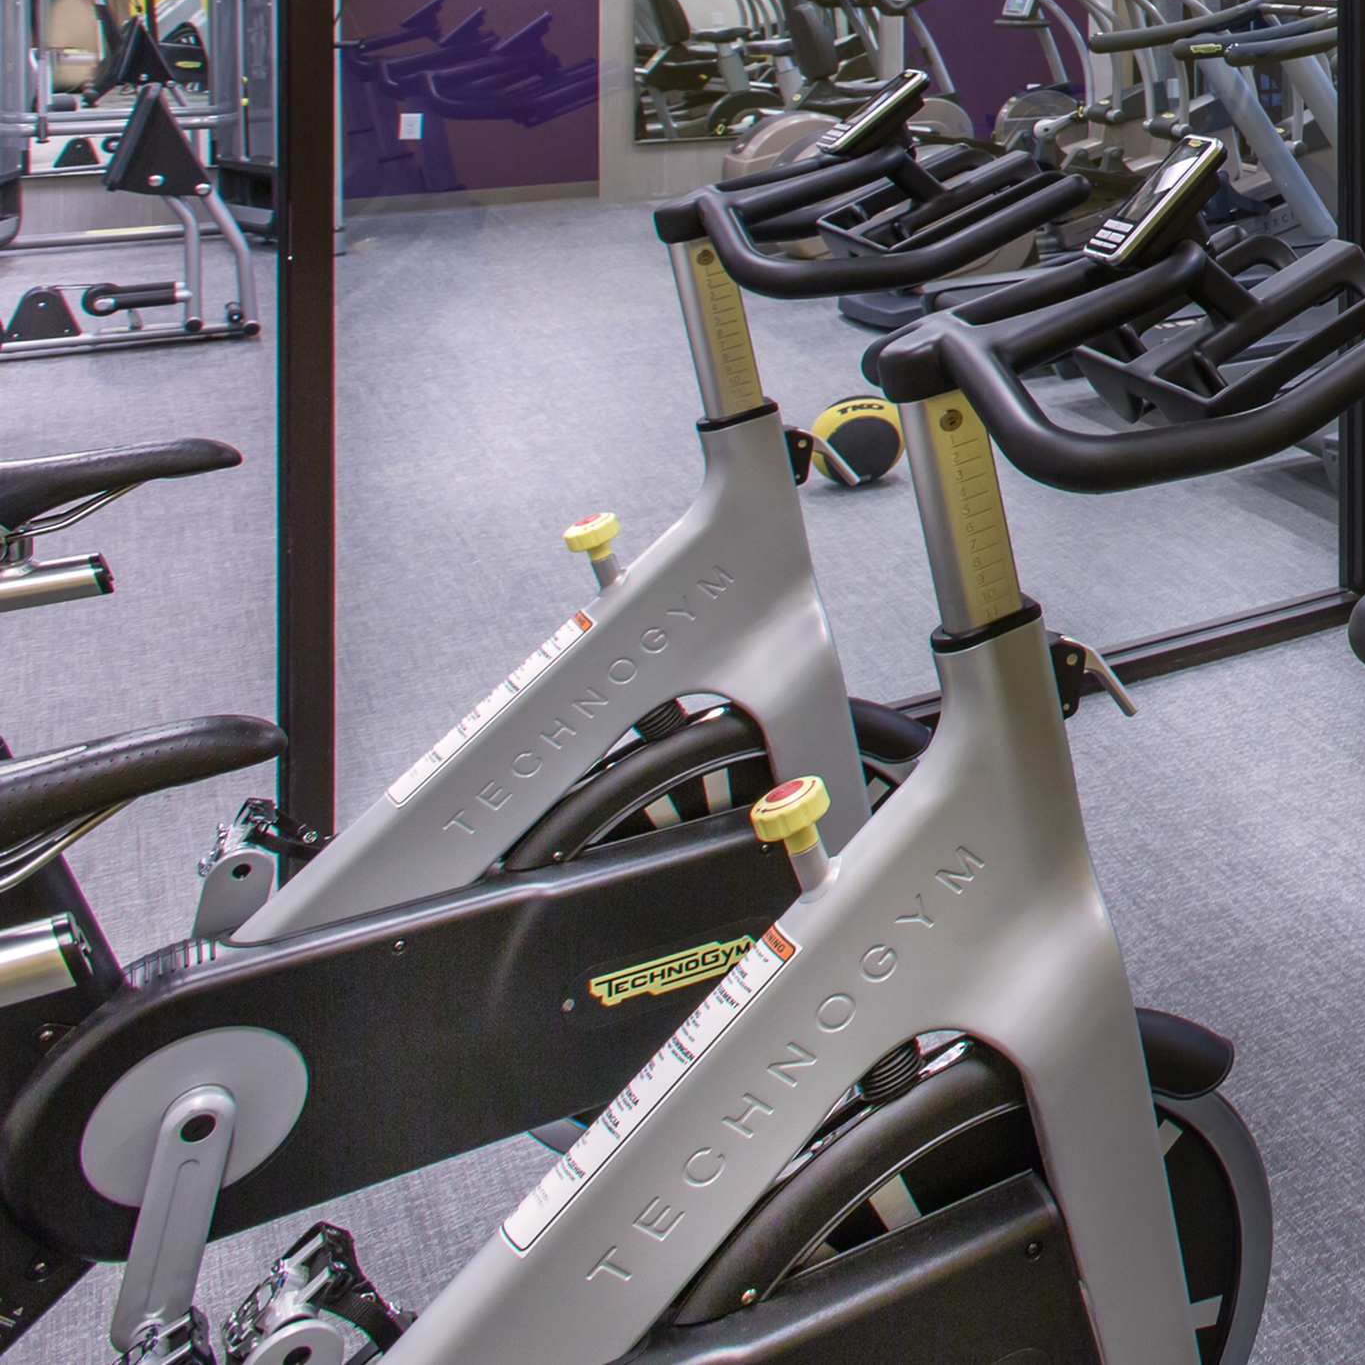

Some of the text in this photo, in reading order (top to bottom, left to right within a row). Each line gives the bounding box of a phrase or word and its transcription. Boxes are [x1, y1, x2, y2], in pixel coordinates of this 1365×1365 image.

[1263, 212, 1295, 232] EXCI
[837, 403, 885, 415] TKO
[442, 565, 735, 835] TECHNOGYM
[594, 940, 751, 999] TECHNOGYM
[585, 845, 986, 1282] TECHNOGYM
